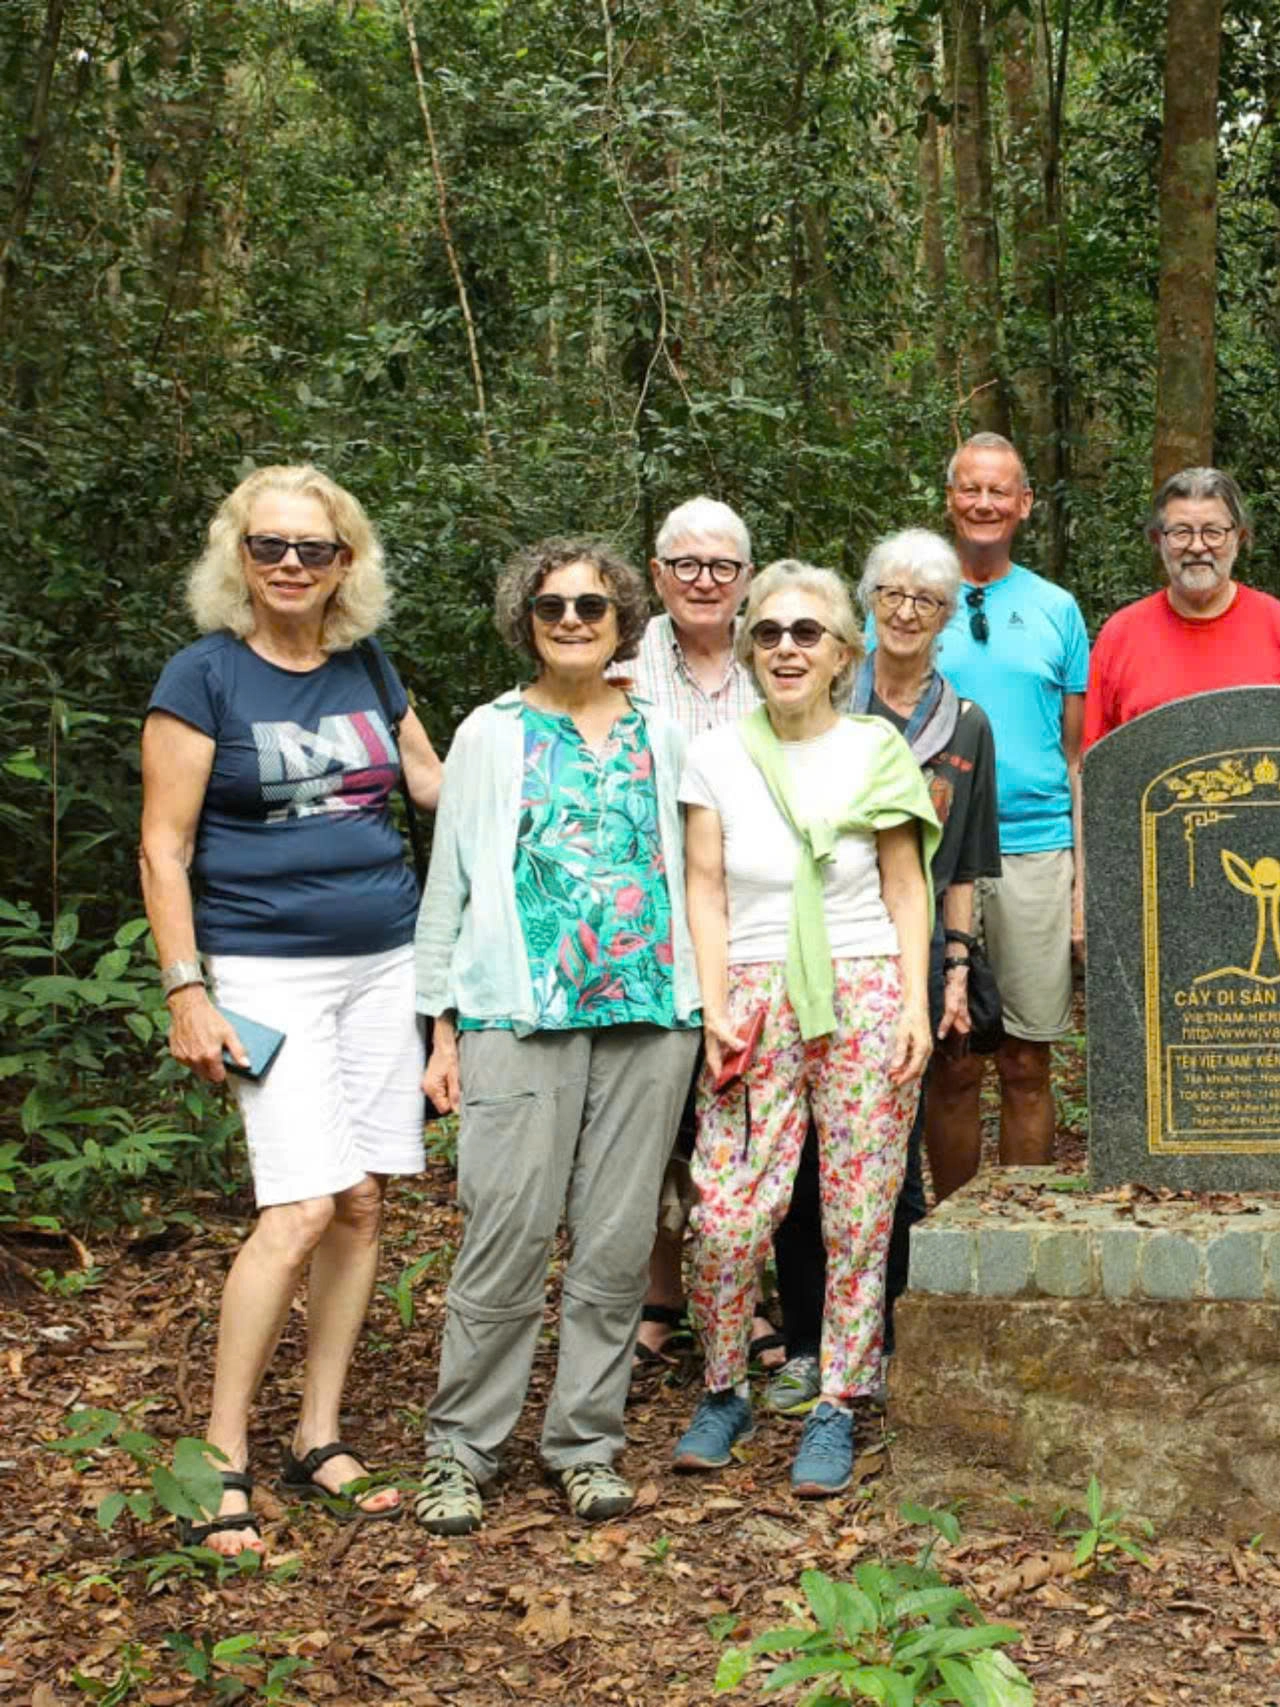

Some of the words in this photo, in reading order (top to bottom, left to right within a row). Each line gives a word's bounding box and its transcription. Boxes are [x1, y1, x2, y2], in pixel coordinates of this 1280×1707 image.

[1174, 985, 1211, 1006] CÂY
[1217, 989, 1235, 1006] DI
[1183, 1012, 1245, 1024] VIETNAM
[1200, 1051, 1222, 1070] VIỆT
